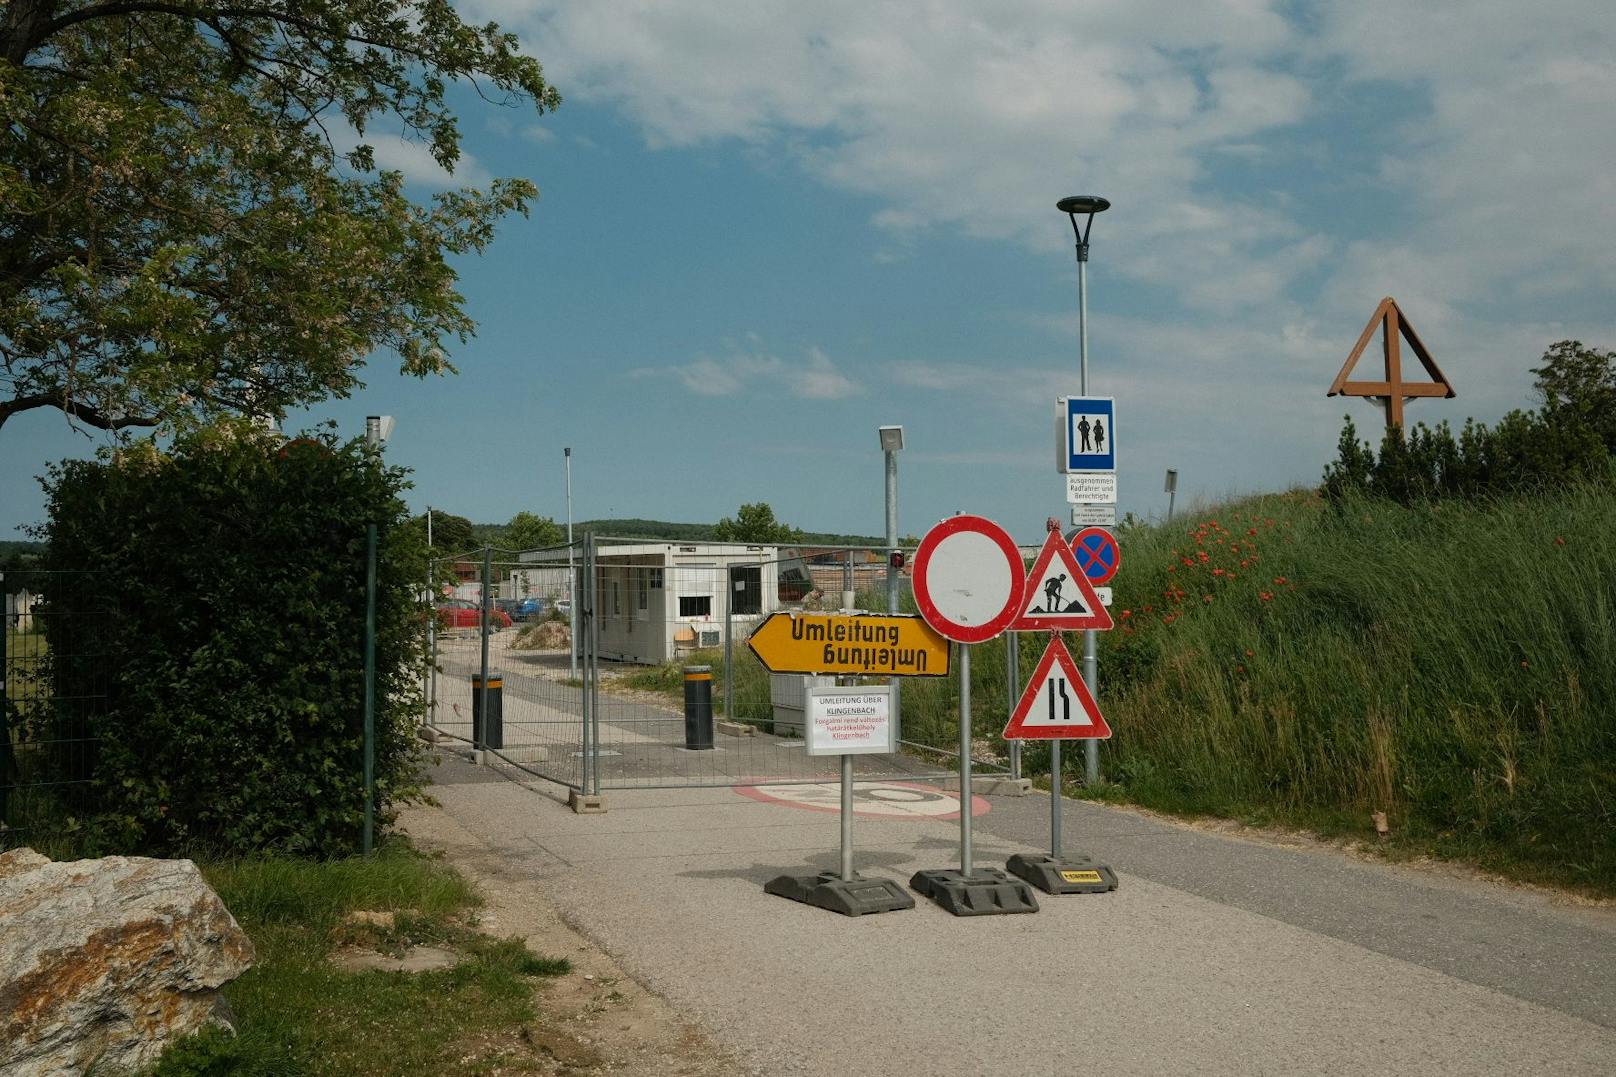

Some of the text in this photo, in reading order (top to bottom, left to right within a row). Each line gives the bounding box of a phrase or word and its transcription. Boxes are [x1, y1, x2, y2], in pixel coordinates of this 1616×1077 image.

[791, 618, 899, 646] Umleitung
[823, 644, 927, 672] Umleitung
[819, 695, 882, 705] UMLEITUNG ÜBER
[826, 707, 876, 715] KLINGENBACH
[832, 731, 870, 740] Klingenbach
